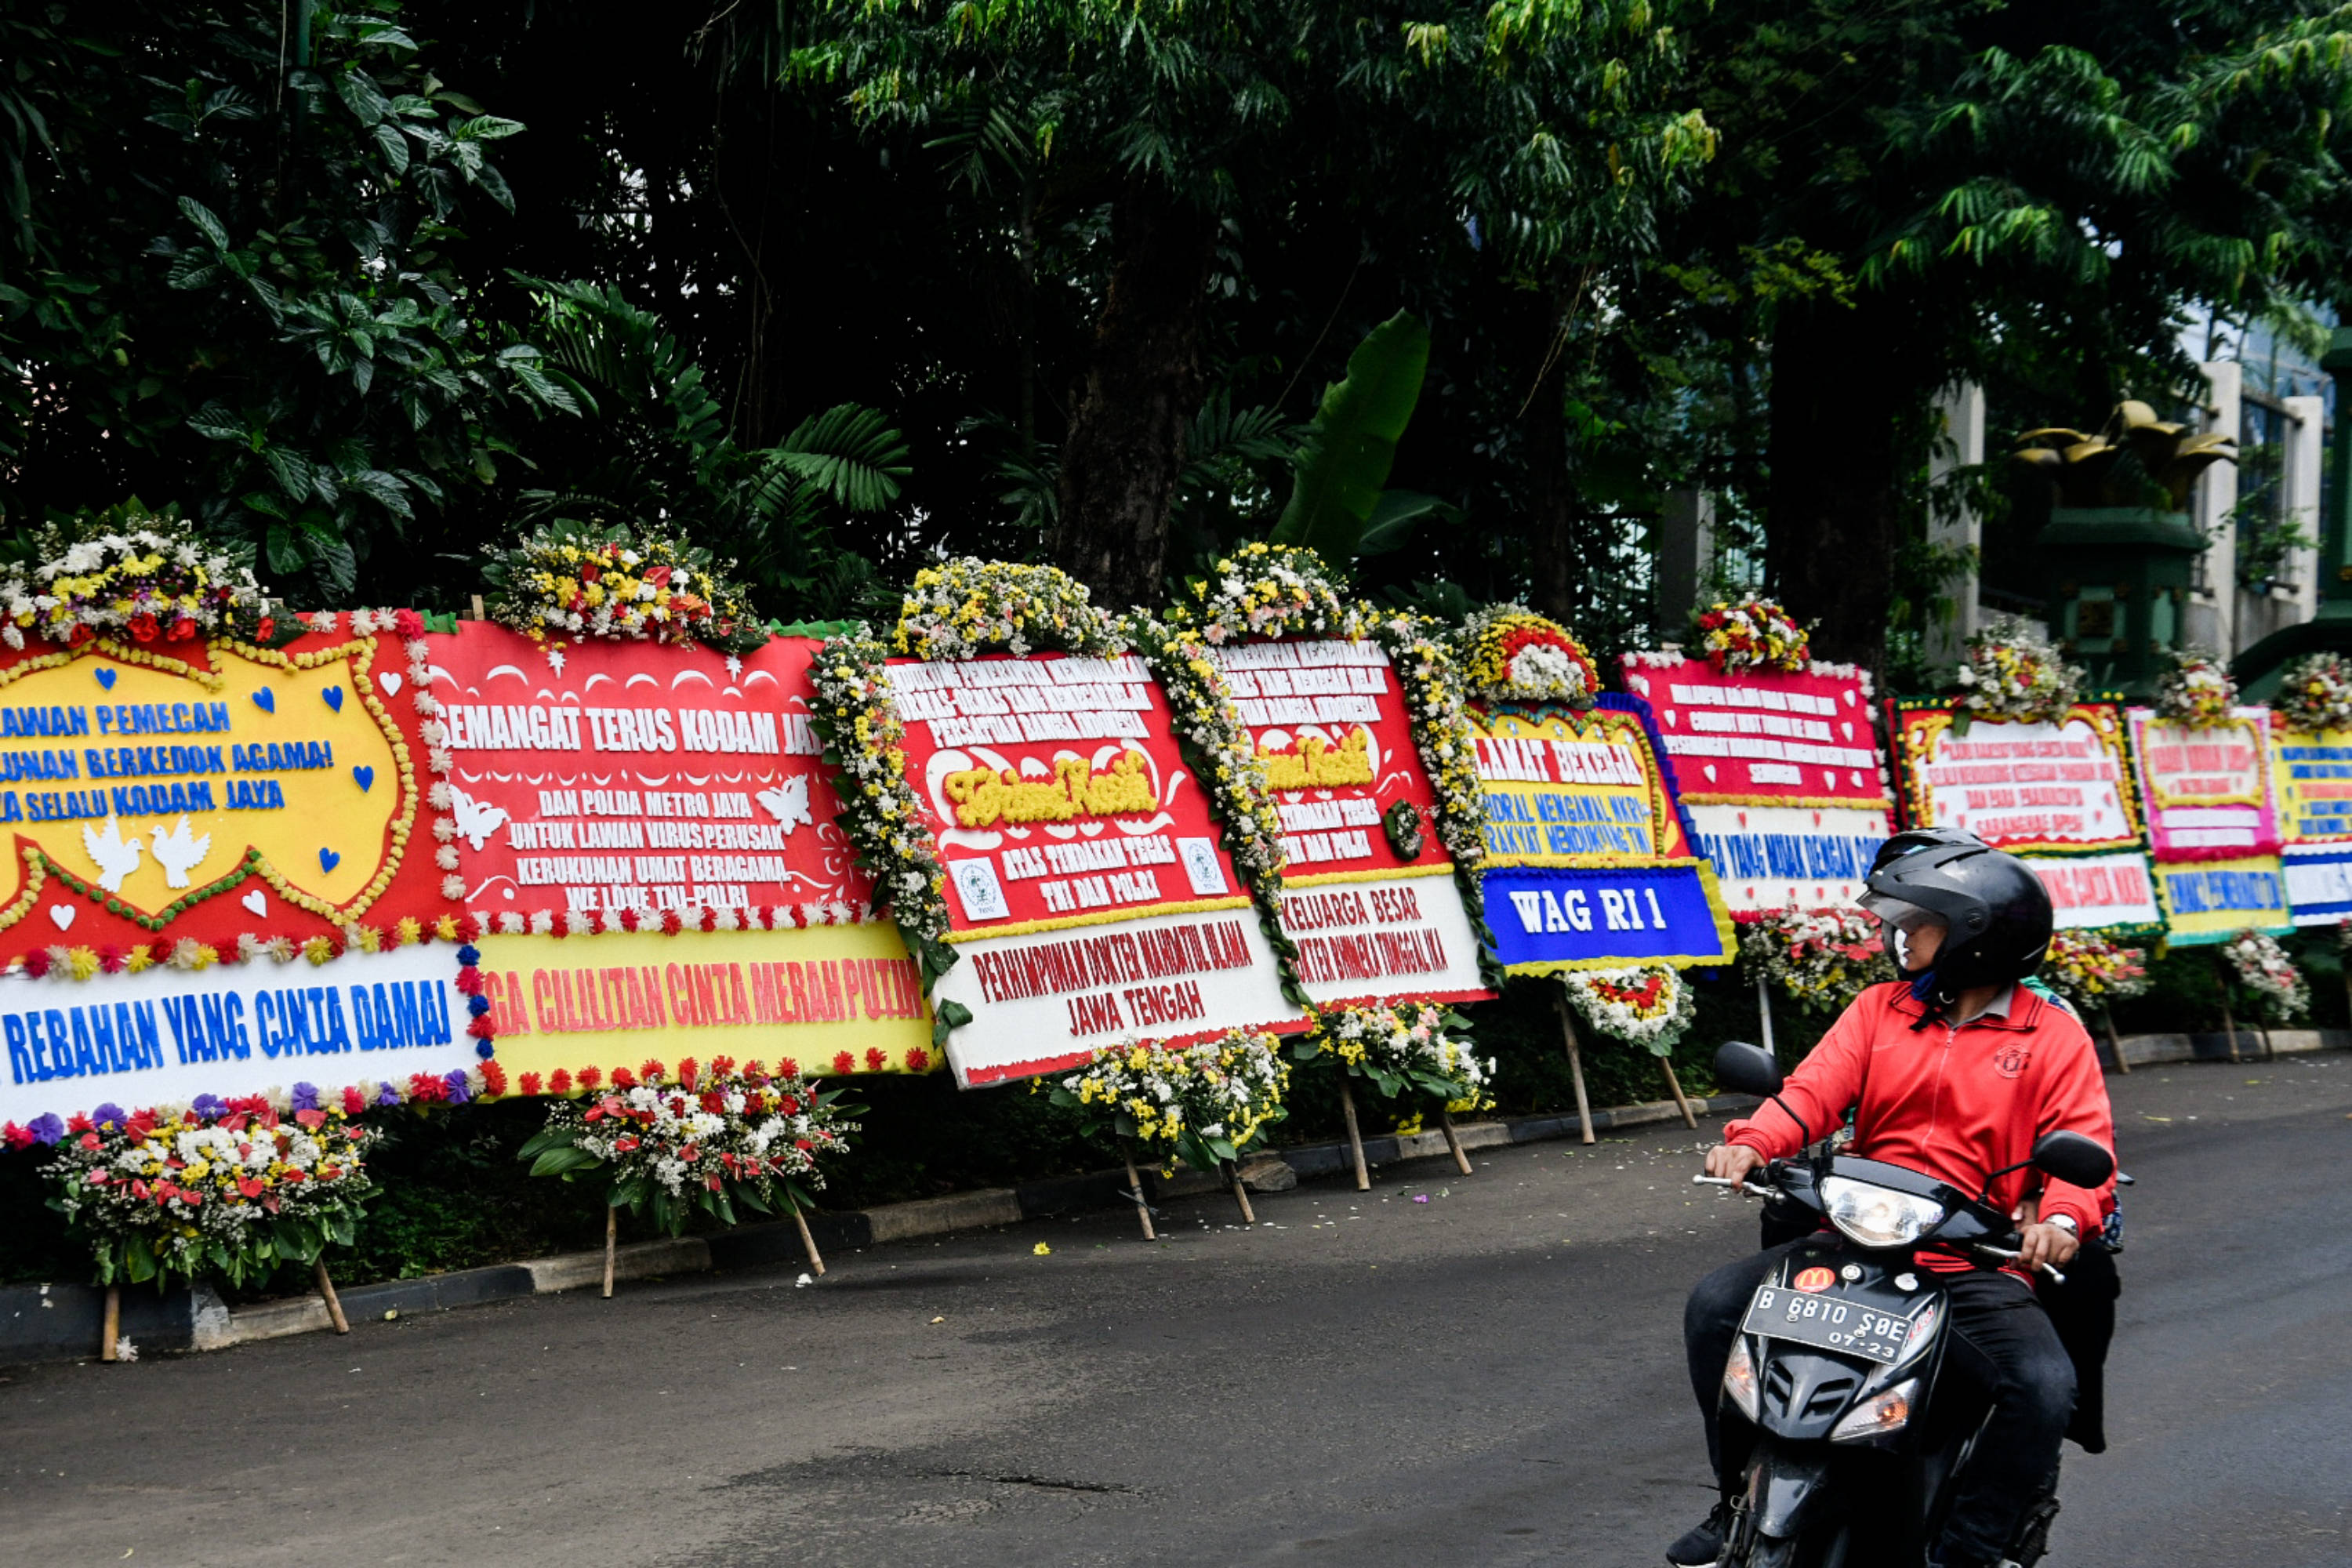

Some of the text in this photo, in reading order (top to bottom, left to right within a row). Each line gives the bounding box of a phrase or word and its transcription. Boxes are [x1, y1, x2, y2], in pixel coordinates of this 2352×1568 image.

[0, 702, 231, 738] AWAN PEMECAH
[435, 704, 826, 756] SEMANGAT TERUS KODAM JAY
[927, 714, 1025, 749] PERSATUAN
[84, 745, 227, 779] BERKEDOK
[232, 740, 336, 772] AGAMA!
[1468, 738, 1552, 783] LAMAT
[25, 789, 108, 822] SELALU
[111, 781, 217, 816] KODAM
[224, 779, 285, 809] JAYA
[538, 789, 753, 818] DAN POLDA METRO JAYA
[510, 821, 786, 851] UNTUK LAWAN VIRUS PERUSAK
[1001, 846, 1047, 880] ATAS
[1044, 838, 1127, 875] TINDAKAN
[1122, 834, 1177, 866] TEGAS
[1483, 824, 1543, 855] RAKYAT
[516, 856, 633, 885] KERUKUNAN
[634, 855, 687, 884] UMAT
[1039, 870, 1161, 913] TNI DAN POLRI
[564, 884, 750, 911] WE LOVE TNI-POLRI
[1279, 887, 1422, 931] KELUARGA BESAR
[1508, 889, 1594, 934] WAG
[1597, 887, 1645, 931] RI
[972, 938, 1091, 1004] PERHIMPUNAN
[1083, 932, 1145, 986] DOKTER
[1201, 920, 1254, 971] ULAMA
[1423, 927, 1450, 972] IKA
[532, 966, 667, 1035] CILILITAN
[666, 962, 753, 1028] CINTA
[750, 960, 846, 1025] MERAH
[841, 957, 924, 1021] PUTIH
[1067, 980, 1207, 1037] JAWA TENGAH
[2, 979, 453, 1085] REBAHAN YANG CINTA DAMAI
[1758, 1290, 1776, 1309] B
[1788, 1296, 1848, 1324] 6810
